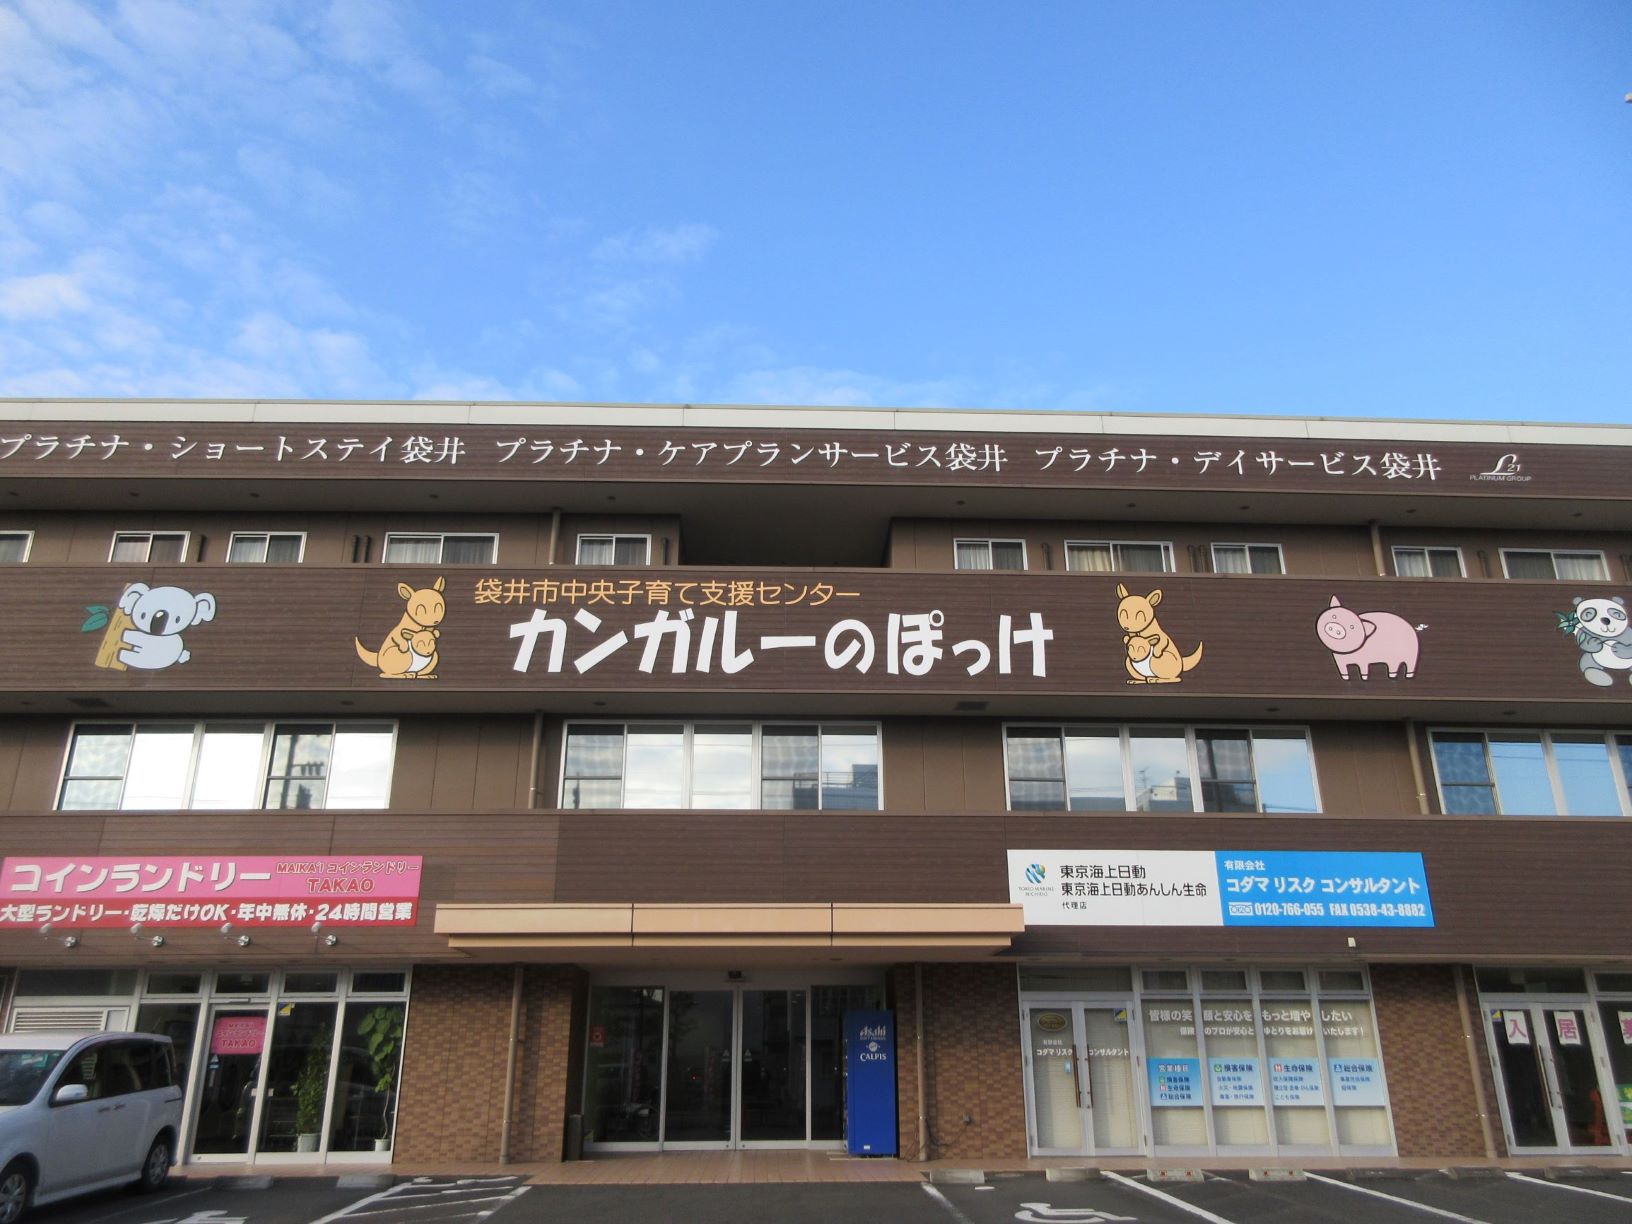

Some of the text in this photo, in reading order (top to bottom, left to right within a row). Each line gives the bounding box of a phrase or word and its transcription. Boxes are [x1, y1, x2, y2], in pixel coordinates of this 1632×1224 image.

[0, 433, 1441, 481] プラチナ・ショートステイ袋井 プラチナ・ケアプランサービス袋井 プラチナ・デイサービス袋井
[474, 579, 861, 607] 袋井市中央子育て支援センター
[509, 607, 1054, 678] カンガルーのぽっけ
[327, 861, 420, 874] コインランドリー
[1060, 864, 1147, 880] 東京海上日動
[1223, 860, 1266, 871] 有限会社
[10, 861, 272, 893] コインランドリー
[307, 878, 375, 894] TAKAO
[1061, 882, 1208, 898] 東京海上日動あんしん生命
[1226, 876, 1421, 895] コダマ リスク コンサルタント
[1062, 901, 1087, 910] 代理店
[1254, 902, 1325, 917] 0120-766-055
[1328, 903, 1349, 916] FAX
[859, 1025, 886, 1037] Asahi
[1509, 1019, 1527, 1039] 入
[1557, 1019, 1577, 1040] 居
[221, 1039, 257, 1049] TAKAO
[859, 1052, 887, 1062] CALPIS
[1224, 1063, 1254, 1073] 損害保険
[1283, 1063, 1314, 1073] 生命保険
[1344, 1063, 1374, 1073] 総合保険
